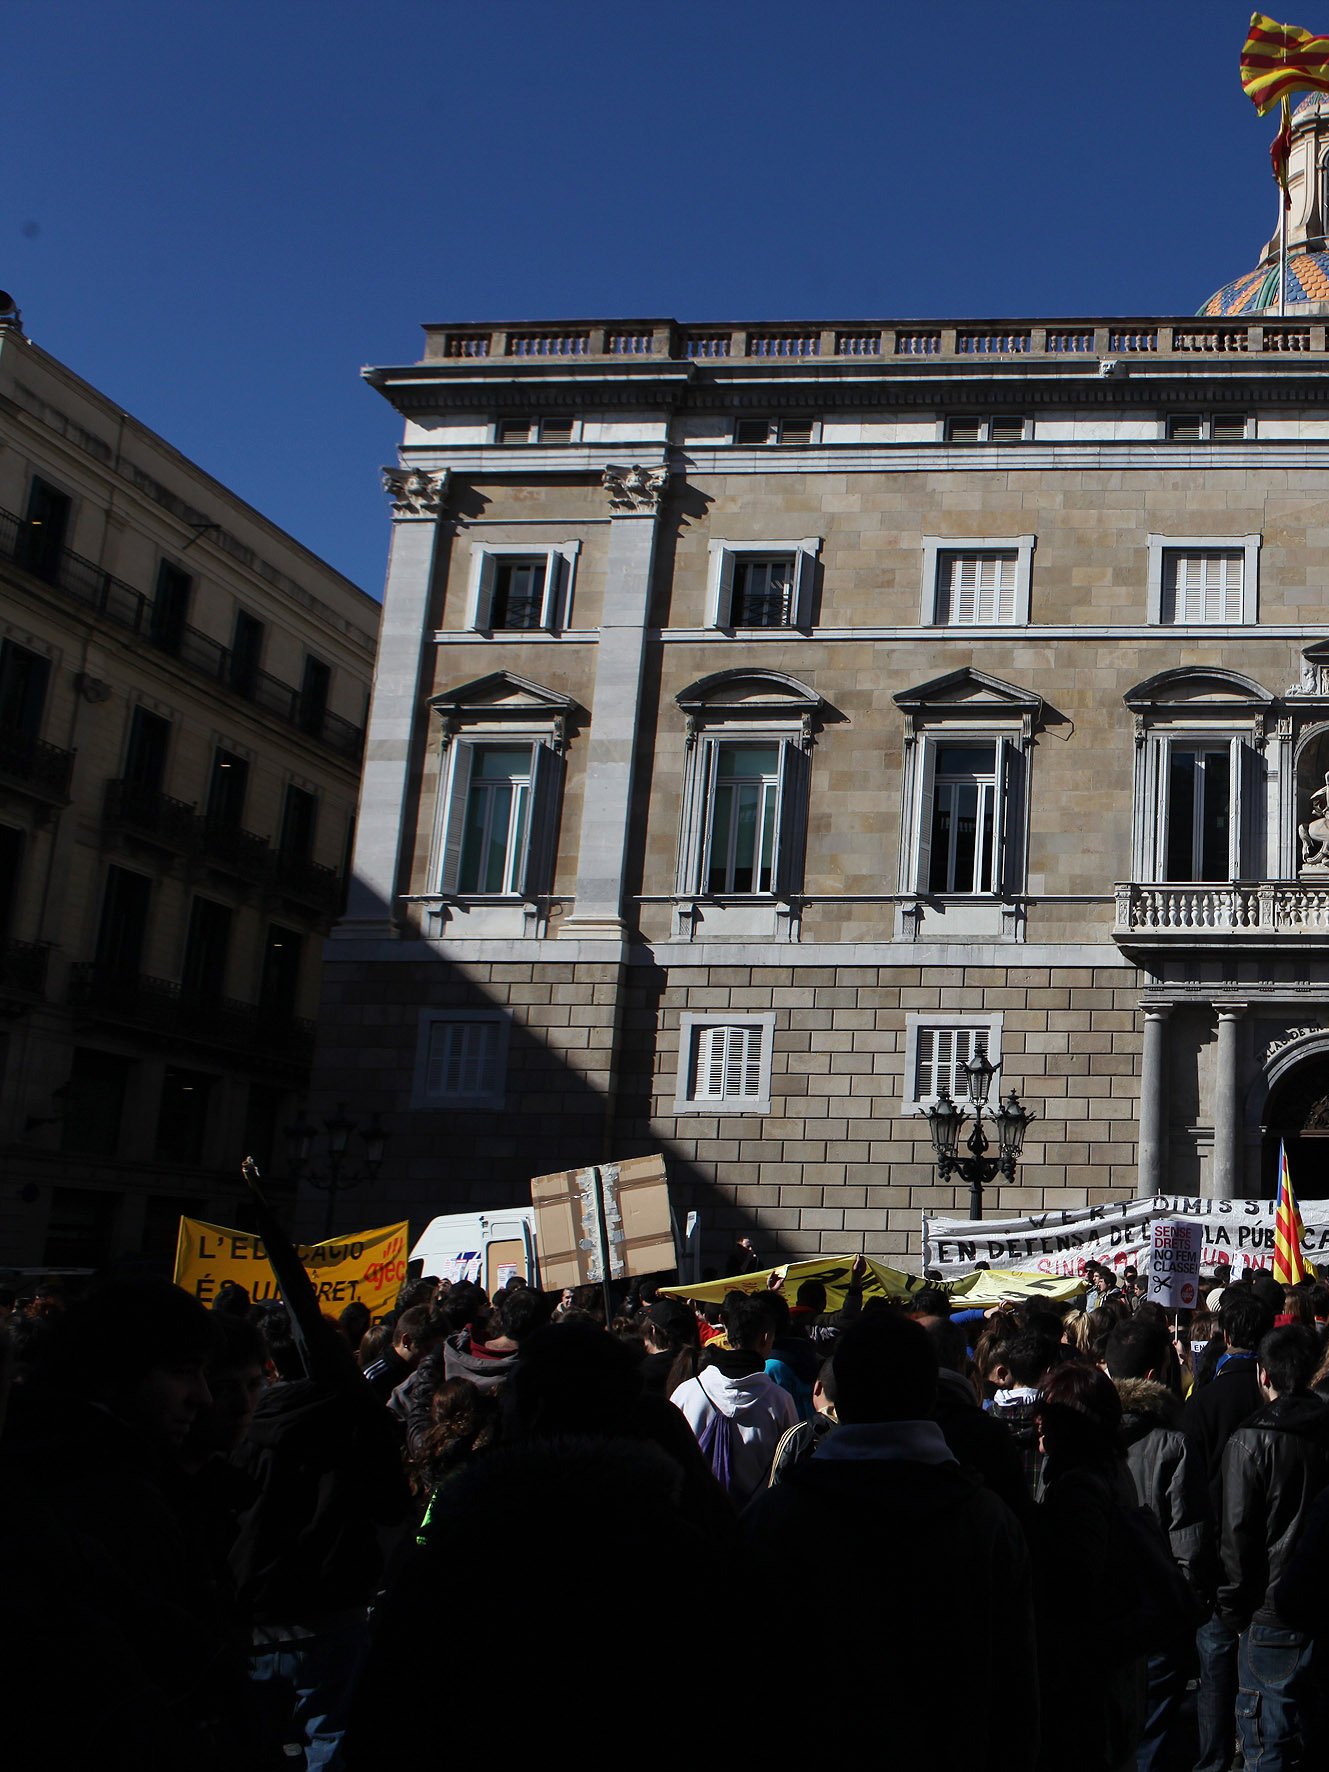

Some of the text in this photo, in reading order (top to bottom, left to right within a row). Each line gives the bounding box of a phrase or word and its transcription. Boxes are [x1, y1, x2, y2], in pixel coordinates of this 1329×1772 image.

[1292, 1027, 1306, 1040] DE
[1154, 1226, 1192, 1239] SENSE
[938, 1240, 976, 1264] EN
[988, 1229, 1100, 1260] DEFENSA
[1110, 1222, 1137, 1247] DE
[1155, 1238, 1191, 1250] DRETS
[1154, 1249, 1197, 1262] NO FEM
[1153, 1261, 1198, 1274] CLASSE!
